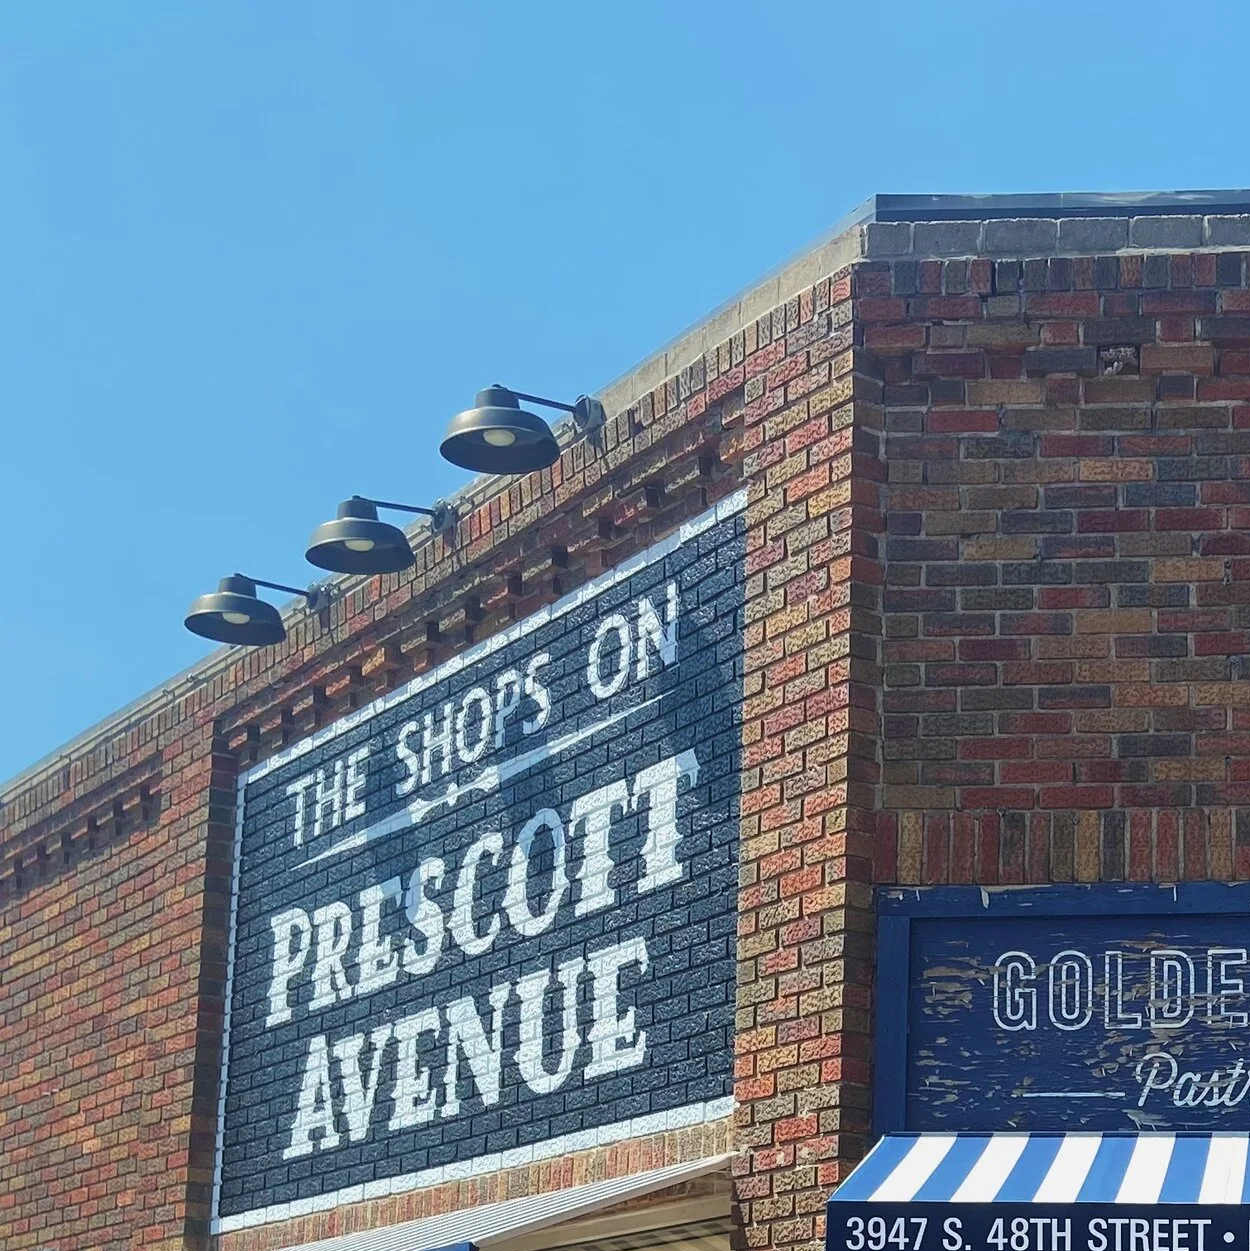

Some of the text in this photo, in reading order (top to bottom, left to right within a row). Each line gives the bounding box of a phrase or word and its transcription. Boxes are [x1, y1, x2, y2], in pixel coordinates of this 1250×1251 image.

[285, 582, 678, 850] THE SHOPS ON
[264, 748, 699, 1029] PRESCOTT
[282, 936, 648, 1161] AVENUE
